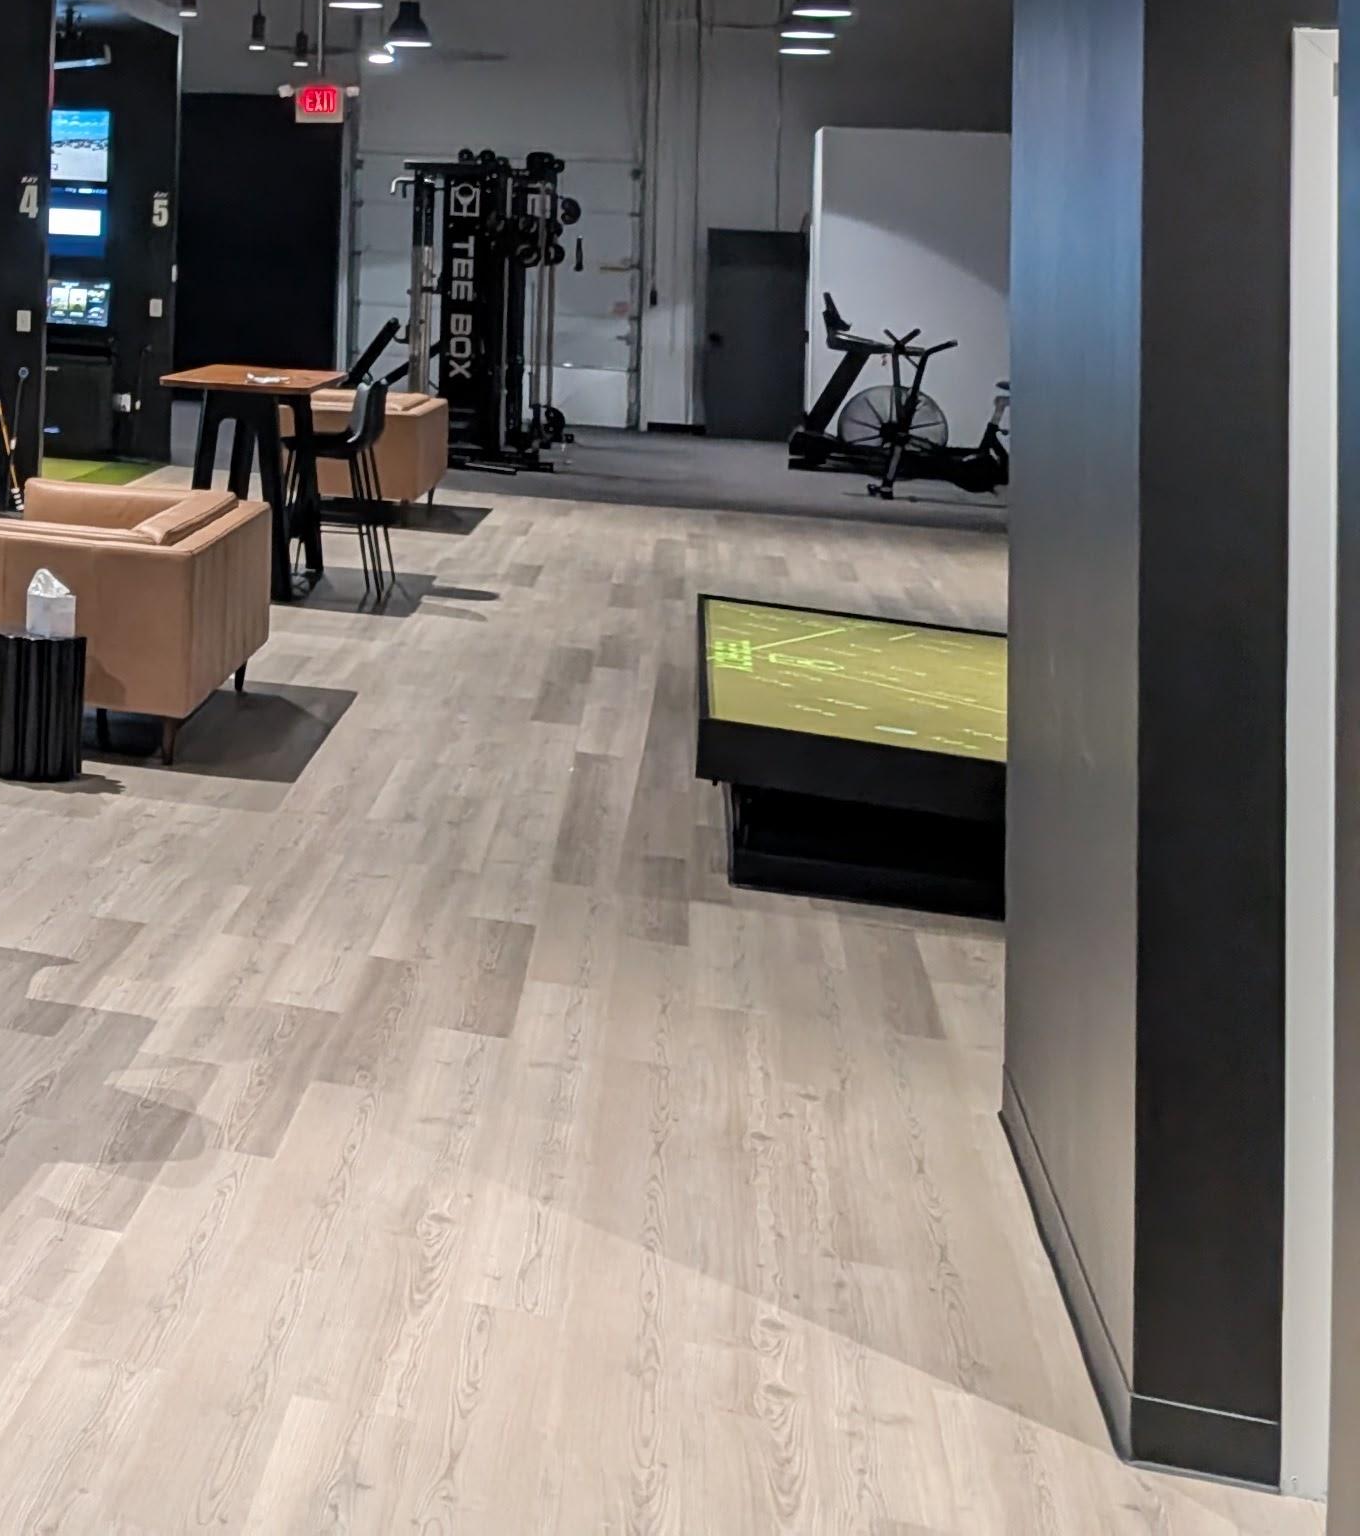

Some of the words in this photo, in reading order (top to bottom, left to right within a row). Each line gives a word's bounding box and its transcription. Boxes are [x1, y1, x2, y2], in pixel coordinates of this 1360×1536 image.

[305, 89, 336, 112] EXIT
[19, 185, 39, 219] 4
[152, 199, 169, 227] 5
[451, 235, 475, 302] TEE
[448, 313, 473, 380] BOX
